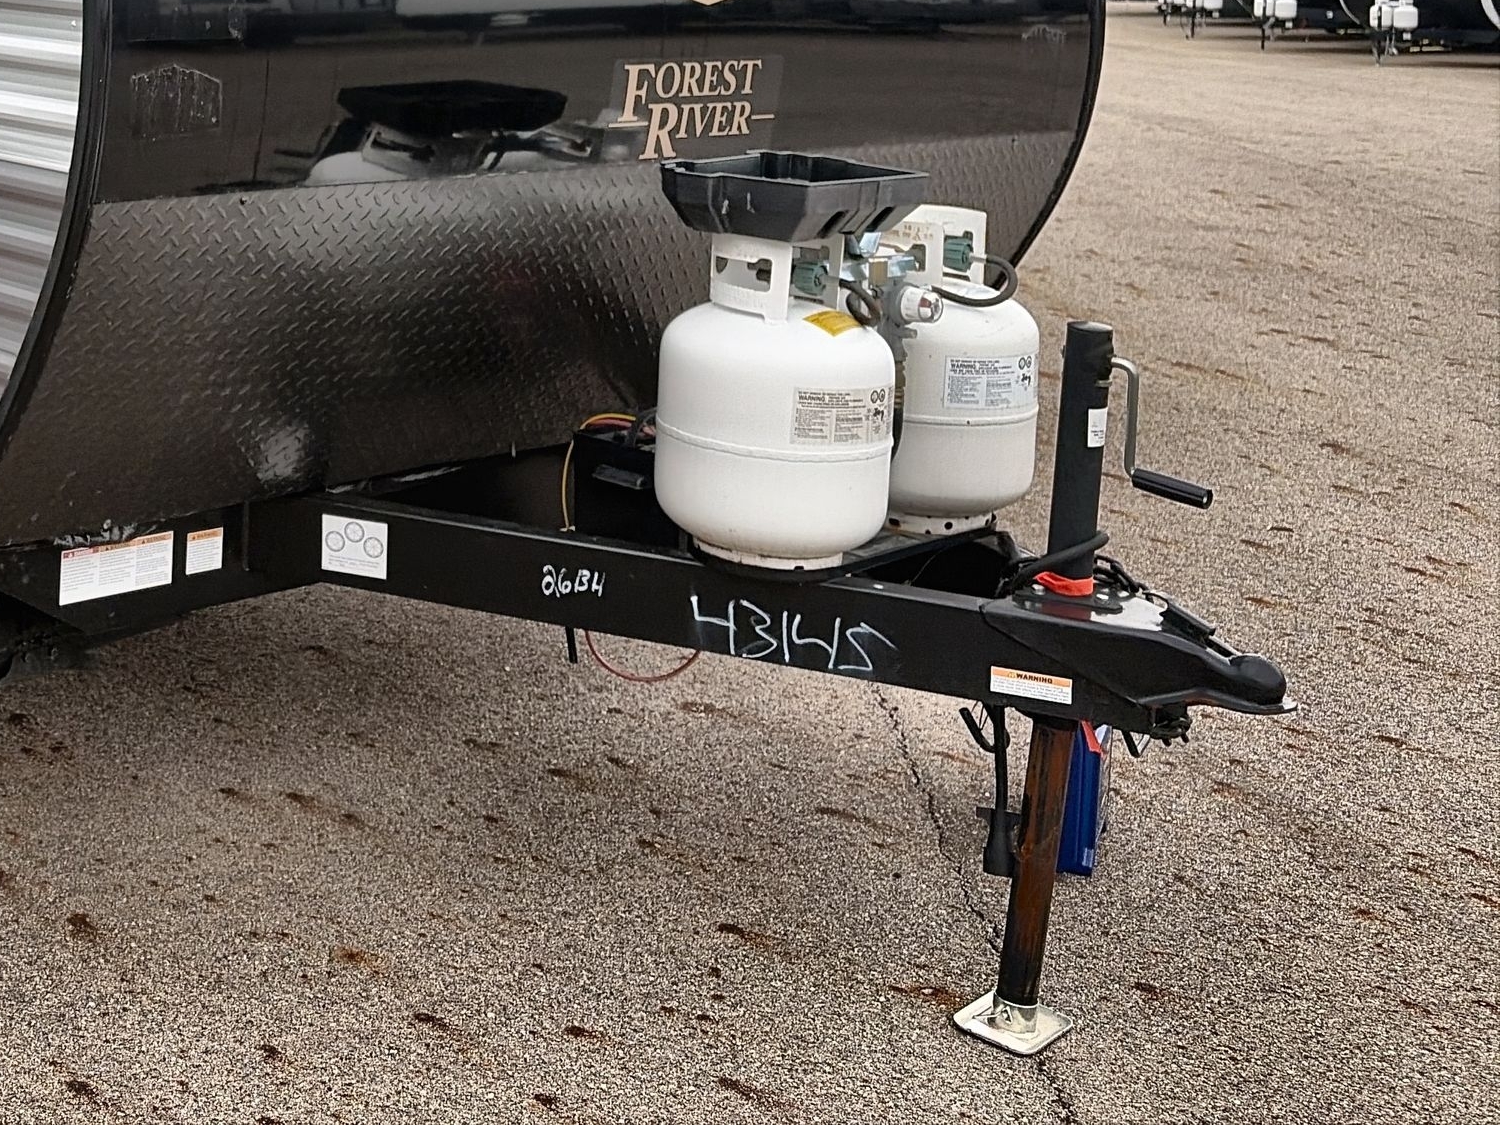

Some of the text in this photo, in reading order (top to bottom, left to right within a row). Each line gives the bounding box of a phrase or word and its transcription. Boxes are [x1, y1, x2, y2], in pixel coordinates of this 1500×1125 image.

[617, 59, 762, 122] FOREST
[638, 100, 752, 160] RIVER
[798, 394, 826, 403] WARNING
[541, 564, 606, 598] 26B4
[1016, 672, 1053, 684] WARNING
